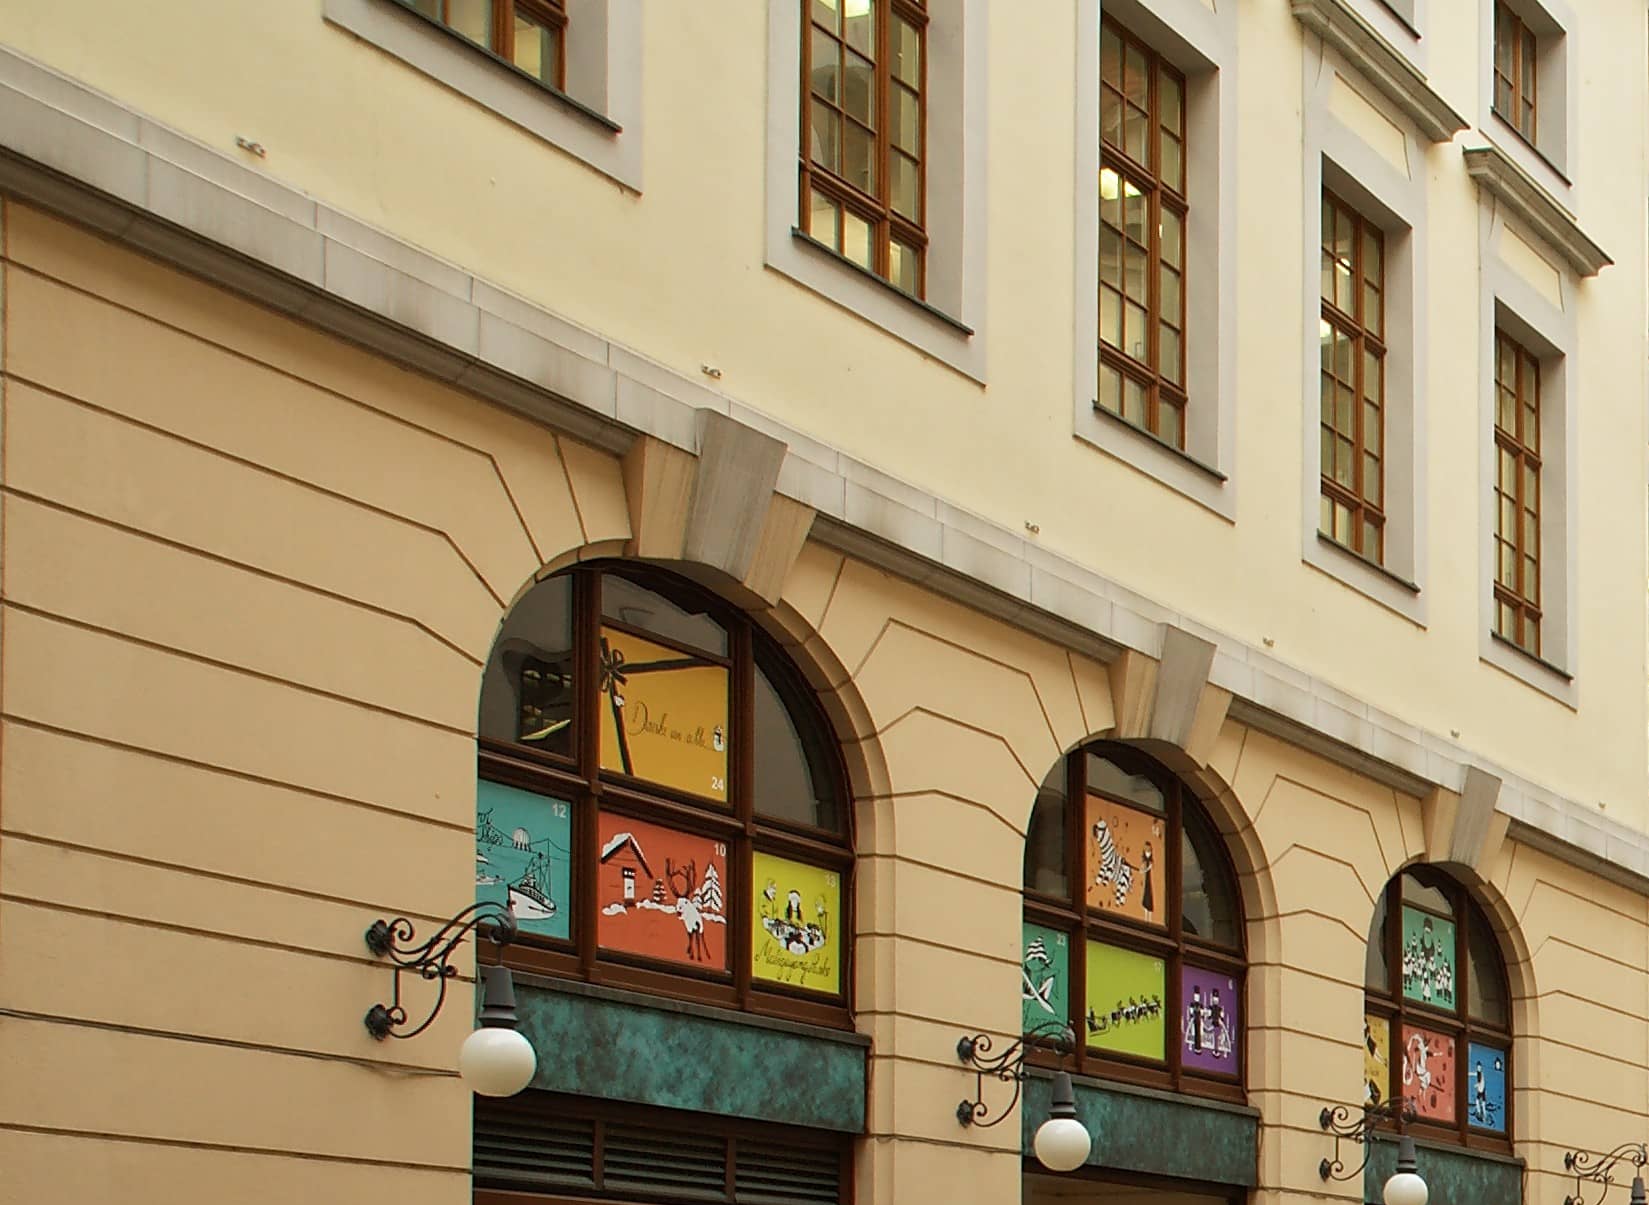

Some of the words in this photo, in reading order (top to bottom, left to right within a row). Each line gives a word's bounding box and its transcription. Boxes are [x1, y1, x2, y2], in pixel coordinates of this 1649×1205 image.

[711, 776, 725, 791] 24
[551, 803, 567, 819] 12
[714, 842, 727, 857] 10
